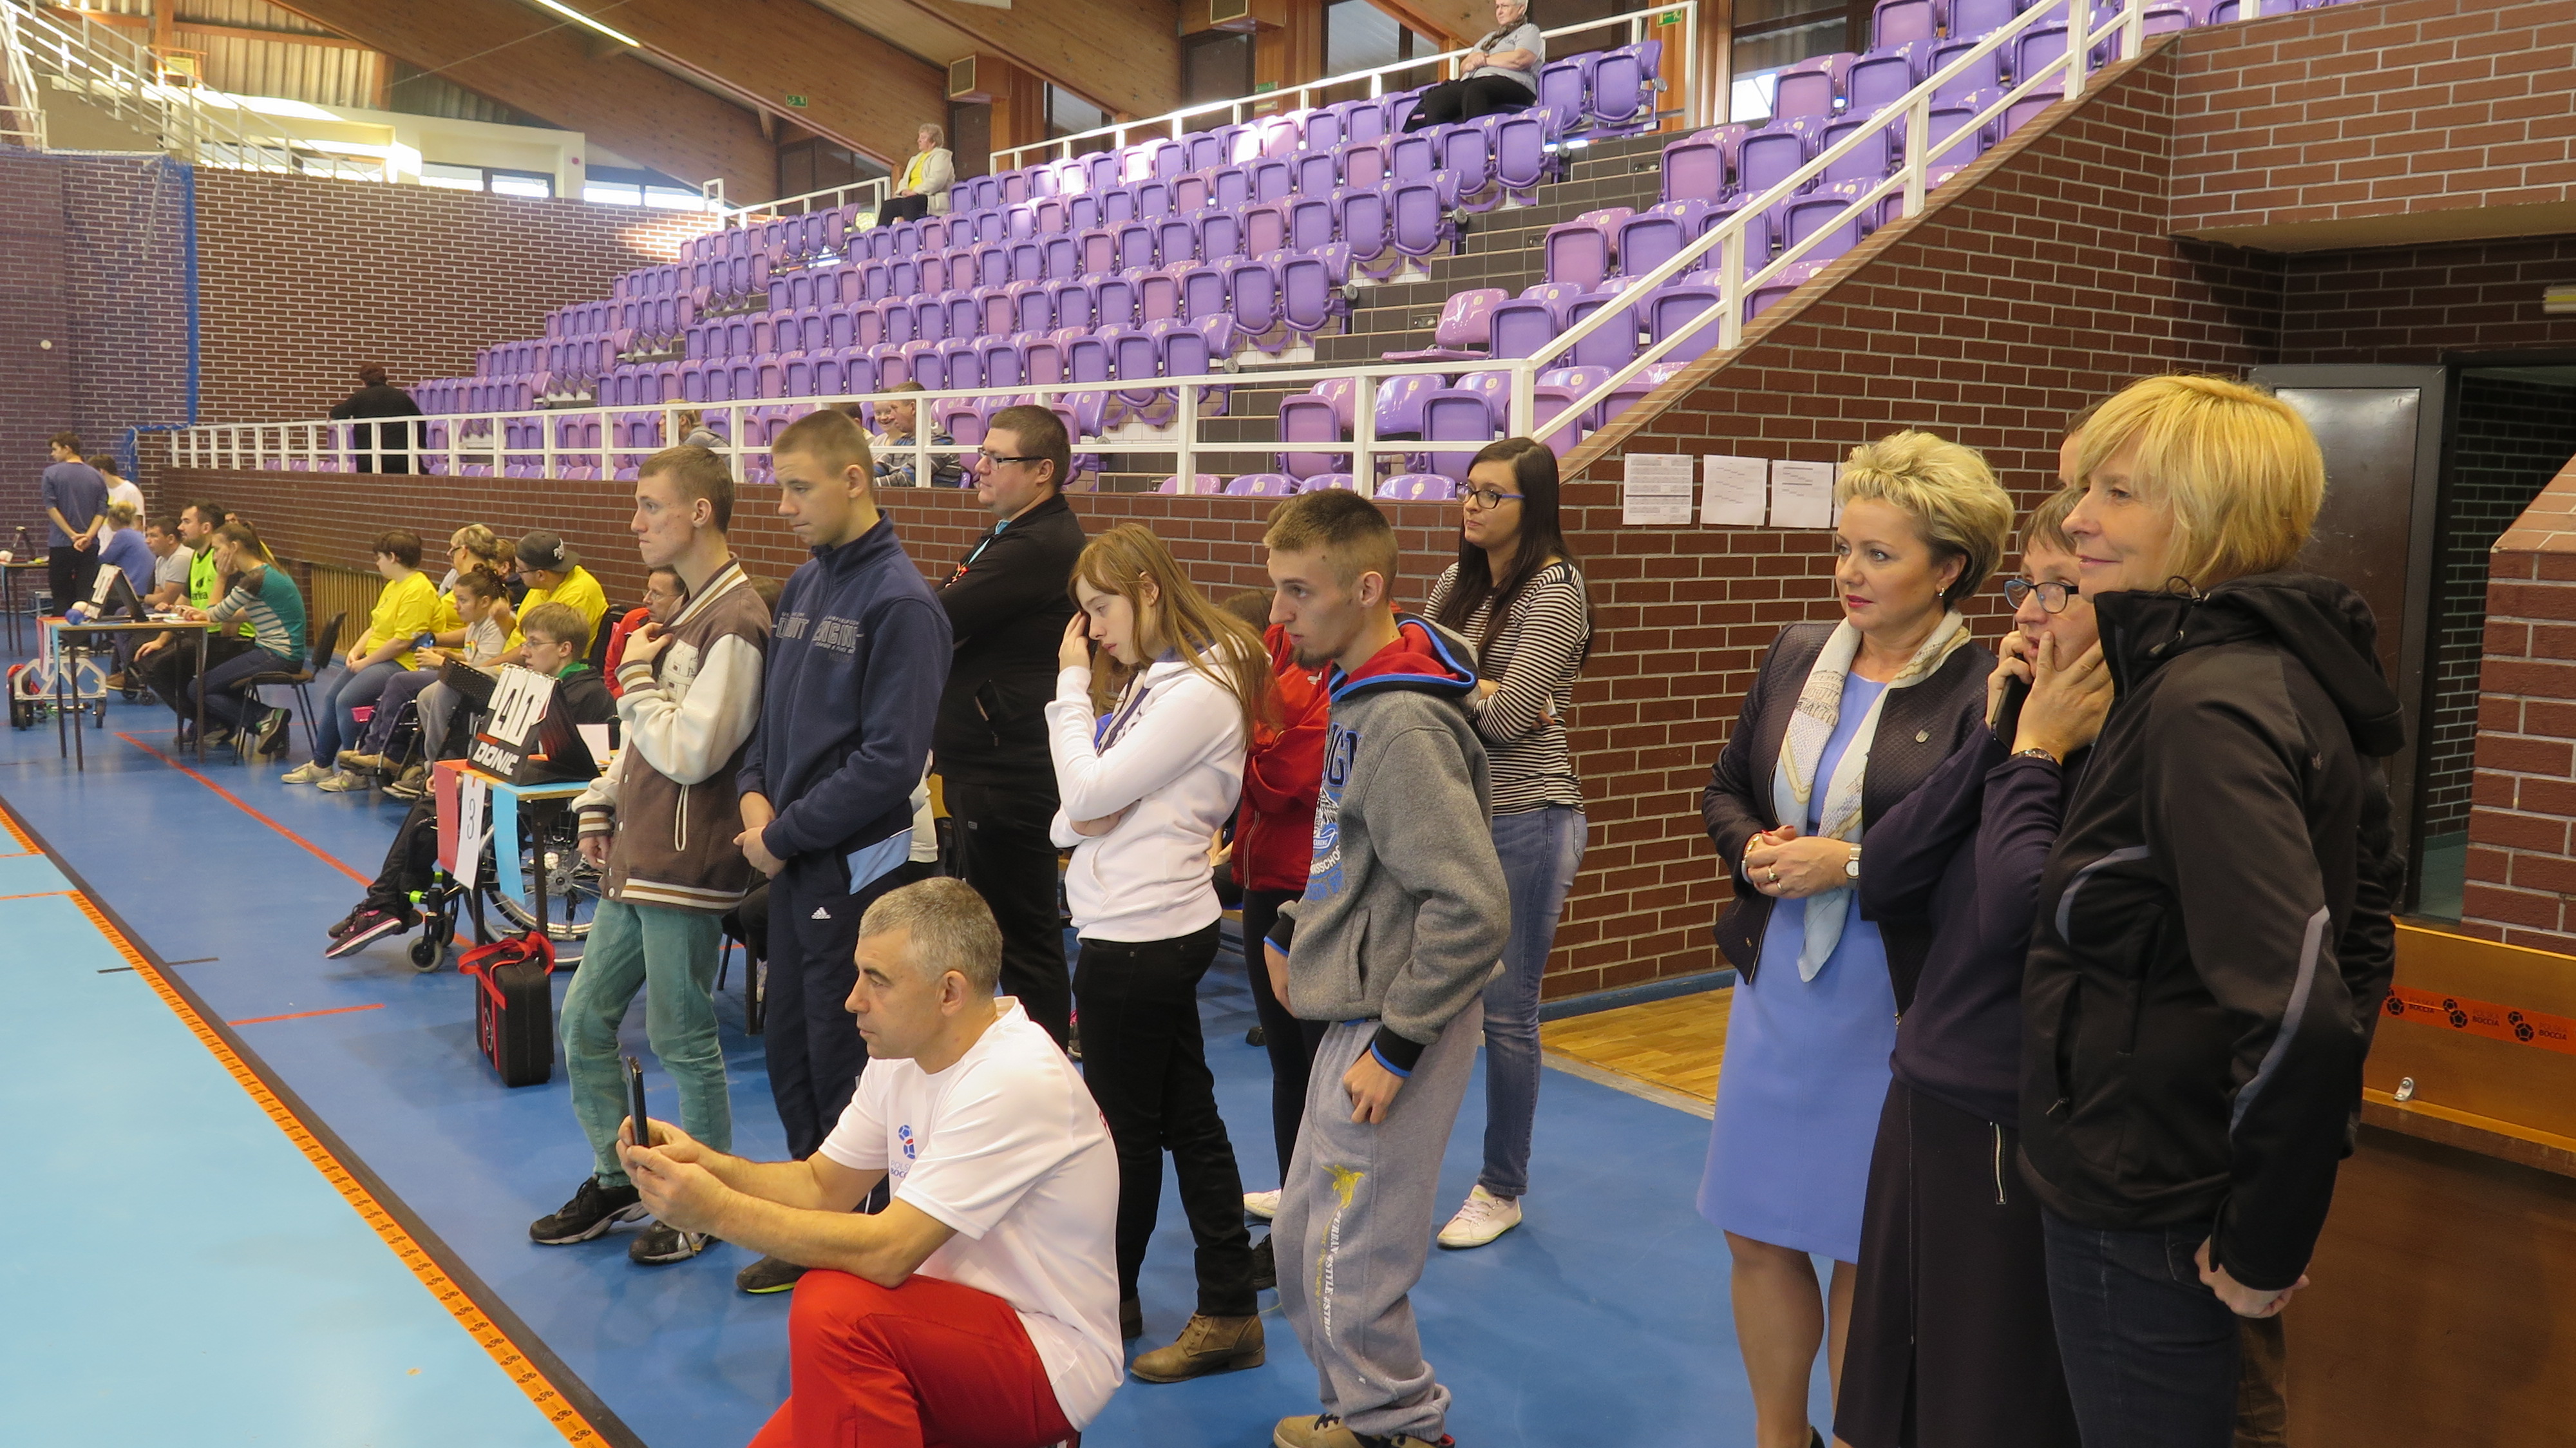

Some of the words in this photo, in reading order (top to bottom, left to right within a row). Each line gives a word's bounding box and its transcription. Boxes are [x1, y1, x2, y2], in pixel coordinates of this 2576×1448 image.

[472, 741, 520, 776] DONIC
[467, 798, 476, 840] 3
[2472, 1015, 2500, 1027] BOCCIA
[2538, 1029, 2568, 1041] BOCCIA
[1331, 1210, 1341, 1254] #URBAN
[1325, 1254, 1334, 1295] #STYLE
